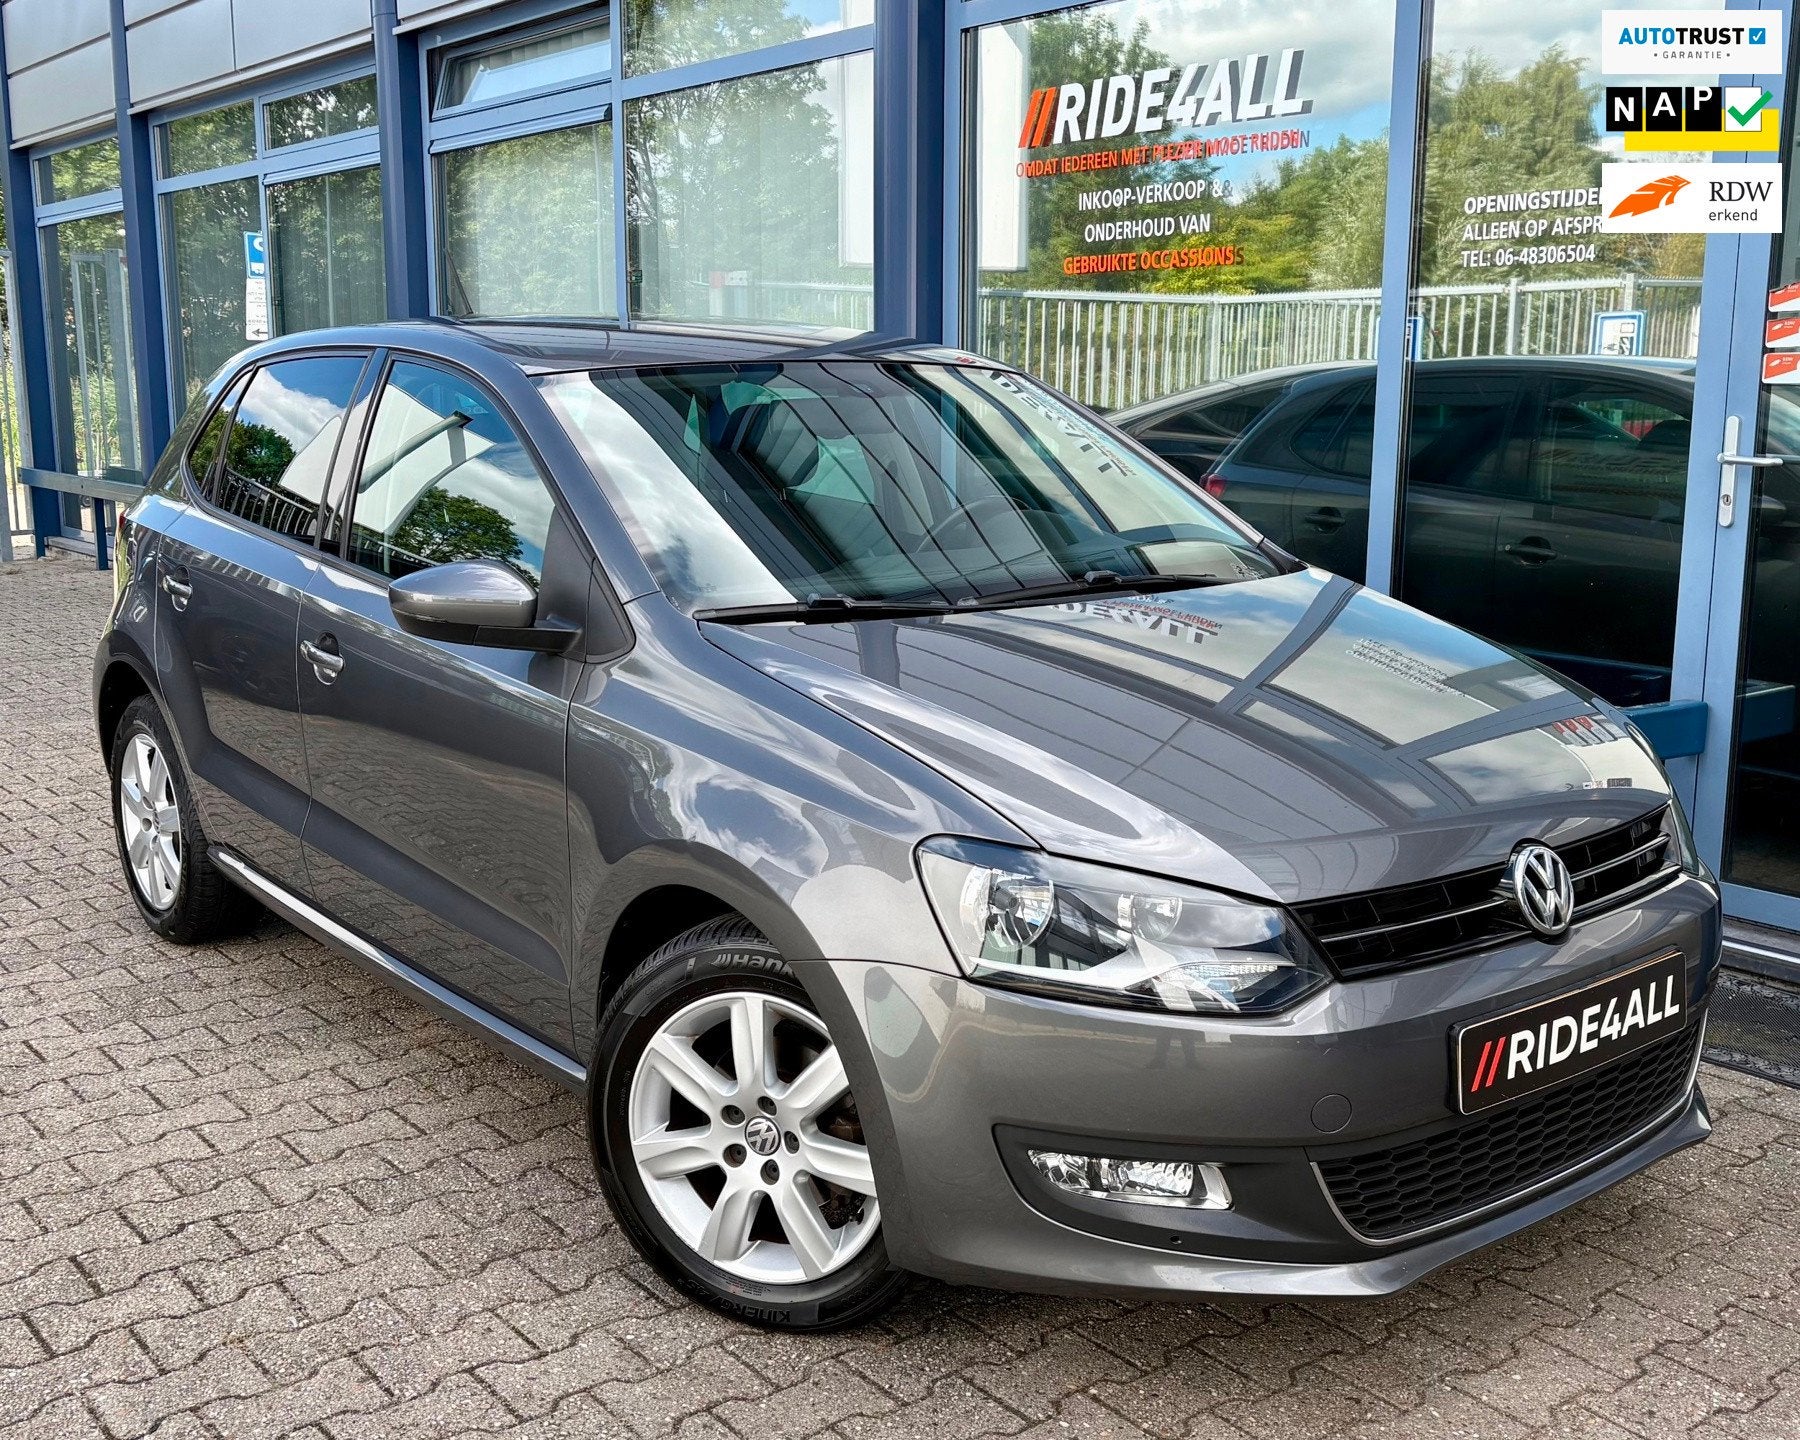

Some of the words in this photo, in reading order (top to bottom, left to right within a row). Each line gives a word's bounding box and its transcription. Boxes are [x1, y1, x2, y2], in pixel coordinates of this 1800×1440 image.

[1016, 158, 1058, 177] OMDAT
[1061, 150, 1118, 173] IEDEREEN
[1121, 145, 1149, 166] MET
[1078, 179, 1206, 211] INKOOP-VERKOOP
[1464, 187, 1602, 215] OPENINGSTIJDE
[1084, 217, 1175, 243] ONDERHOUD
[1180, 213, 1211, 234] VAN
[1462, 220, 1521, 241] ALLEEN
[1524, 219, 1548, 238] OP
[1063, 252, 1137, 275] GEBRUIKTE
[1140, 246, 1235, 270] OCCASSIONS
[1461, 249, 1491, 267] TEL:
[1495, 243, 1596, 266] 06-48306504
